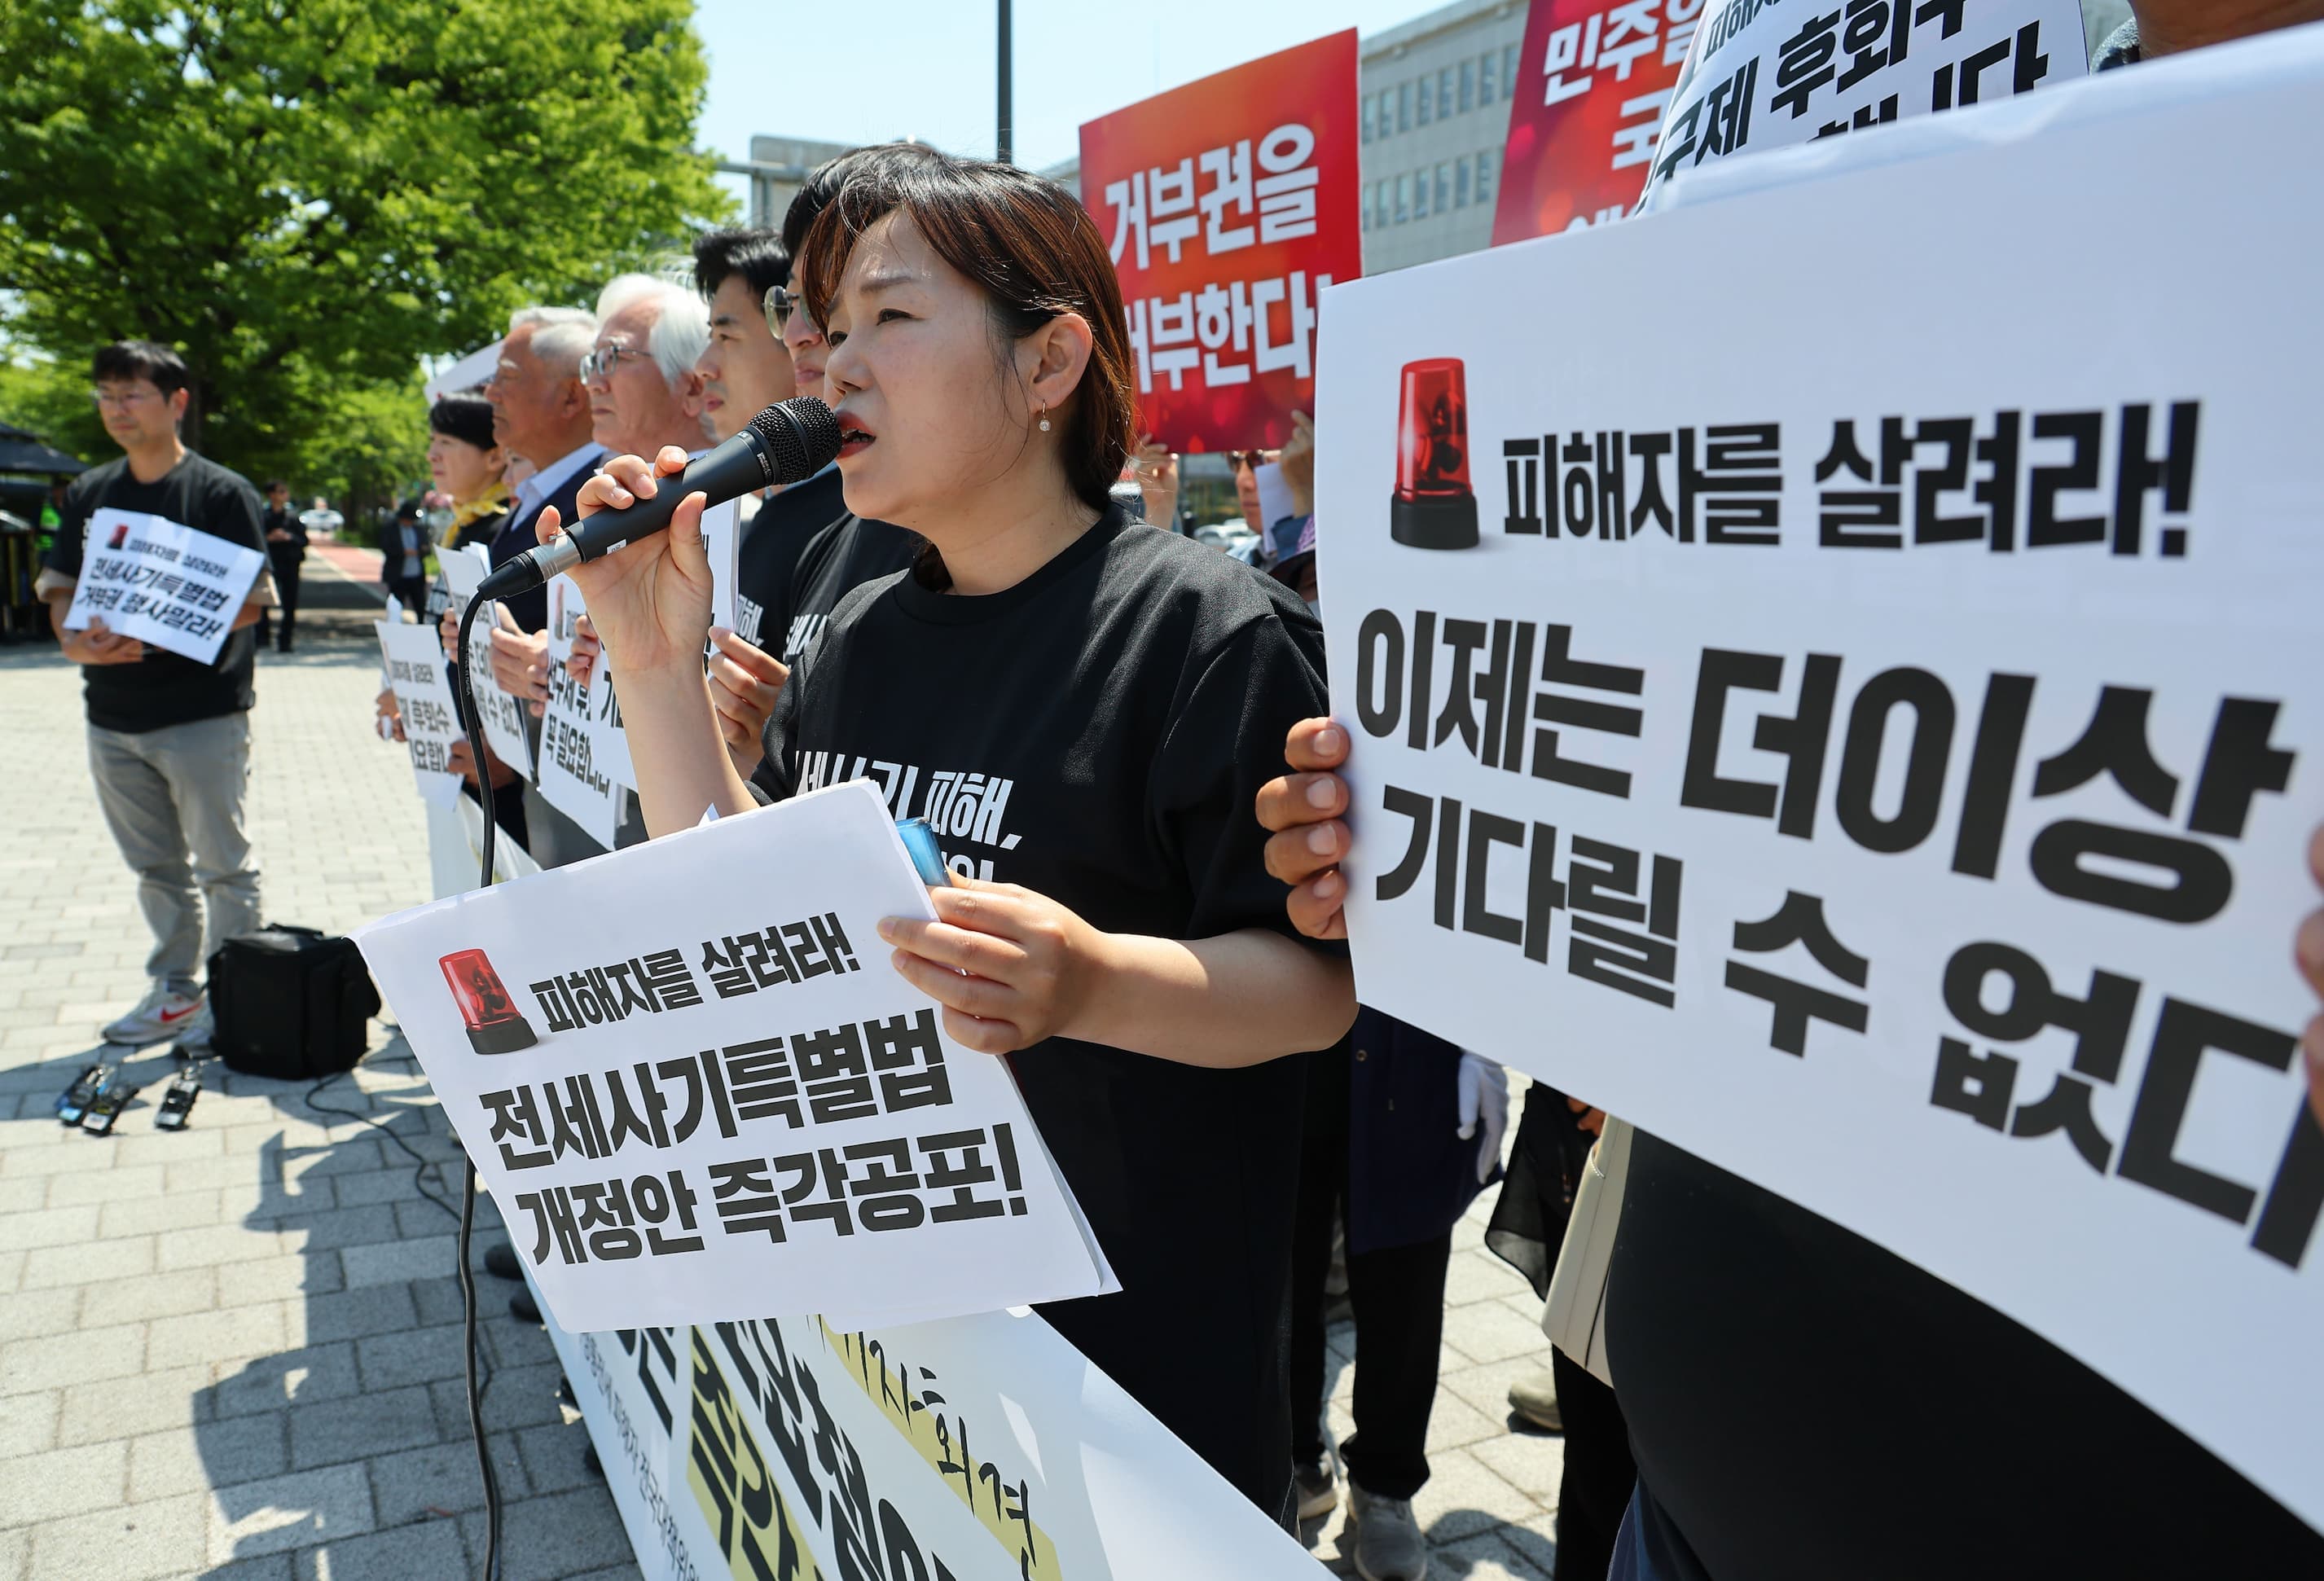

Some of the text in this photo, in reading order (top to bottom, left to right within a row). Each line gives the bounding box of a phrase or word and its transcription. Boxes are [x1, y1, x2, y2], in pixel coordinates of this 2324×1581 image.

[1105, 123, 1320, 270] 거부권을
[1503, 400, 2201, 559] 피해자를 살려라!
[90, 556, 231, 612] 전세사기특별법
[923, 771, 1023, 850] 피해,
[1355, 606, 2299, 924] 이제는 더이상
[528, 911, 860, 1034] 피해자를 살려라!
[1376, 784, 1684, 1010] 기다릴
[1724, 889, 1870, 1058] 수
[479, 1008, 954, 1172] 전세사기특별법
[516, 1122, 1028, 1267] 개정안 즉각공포!
